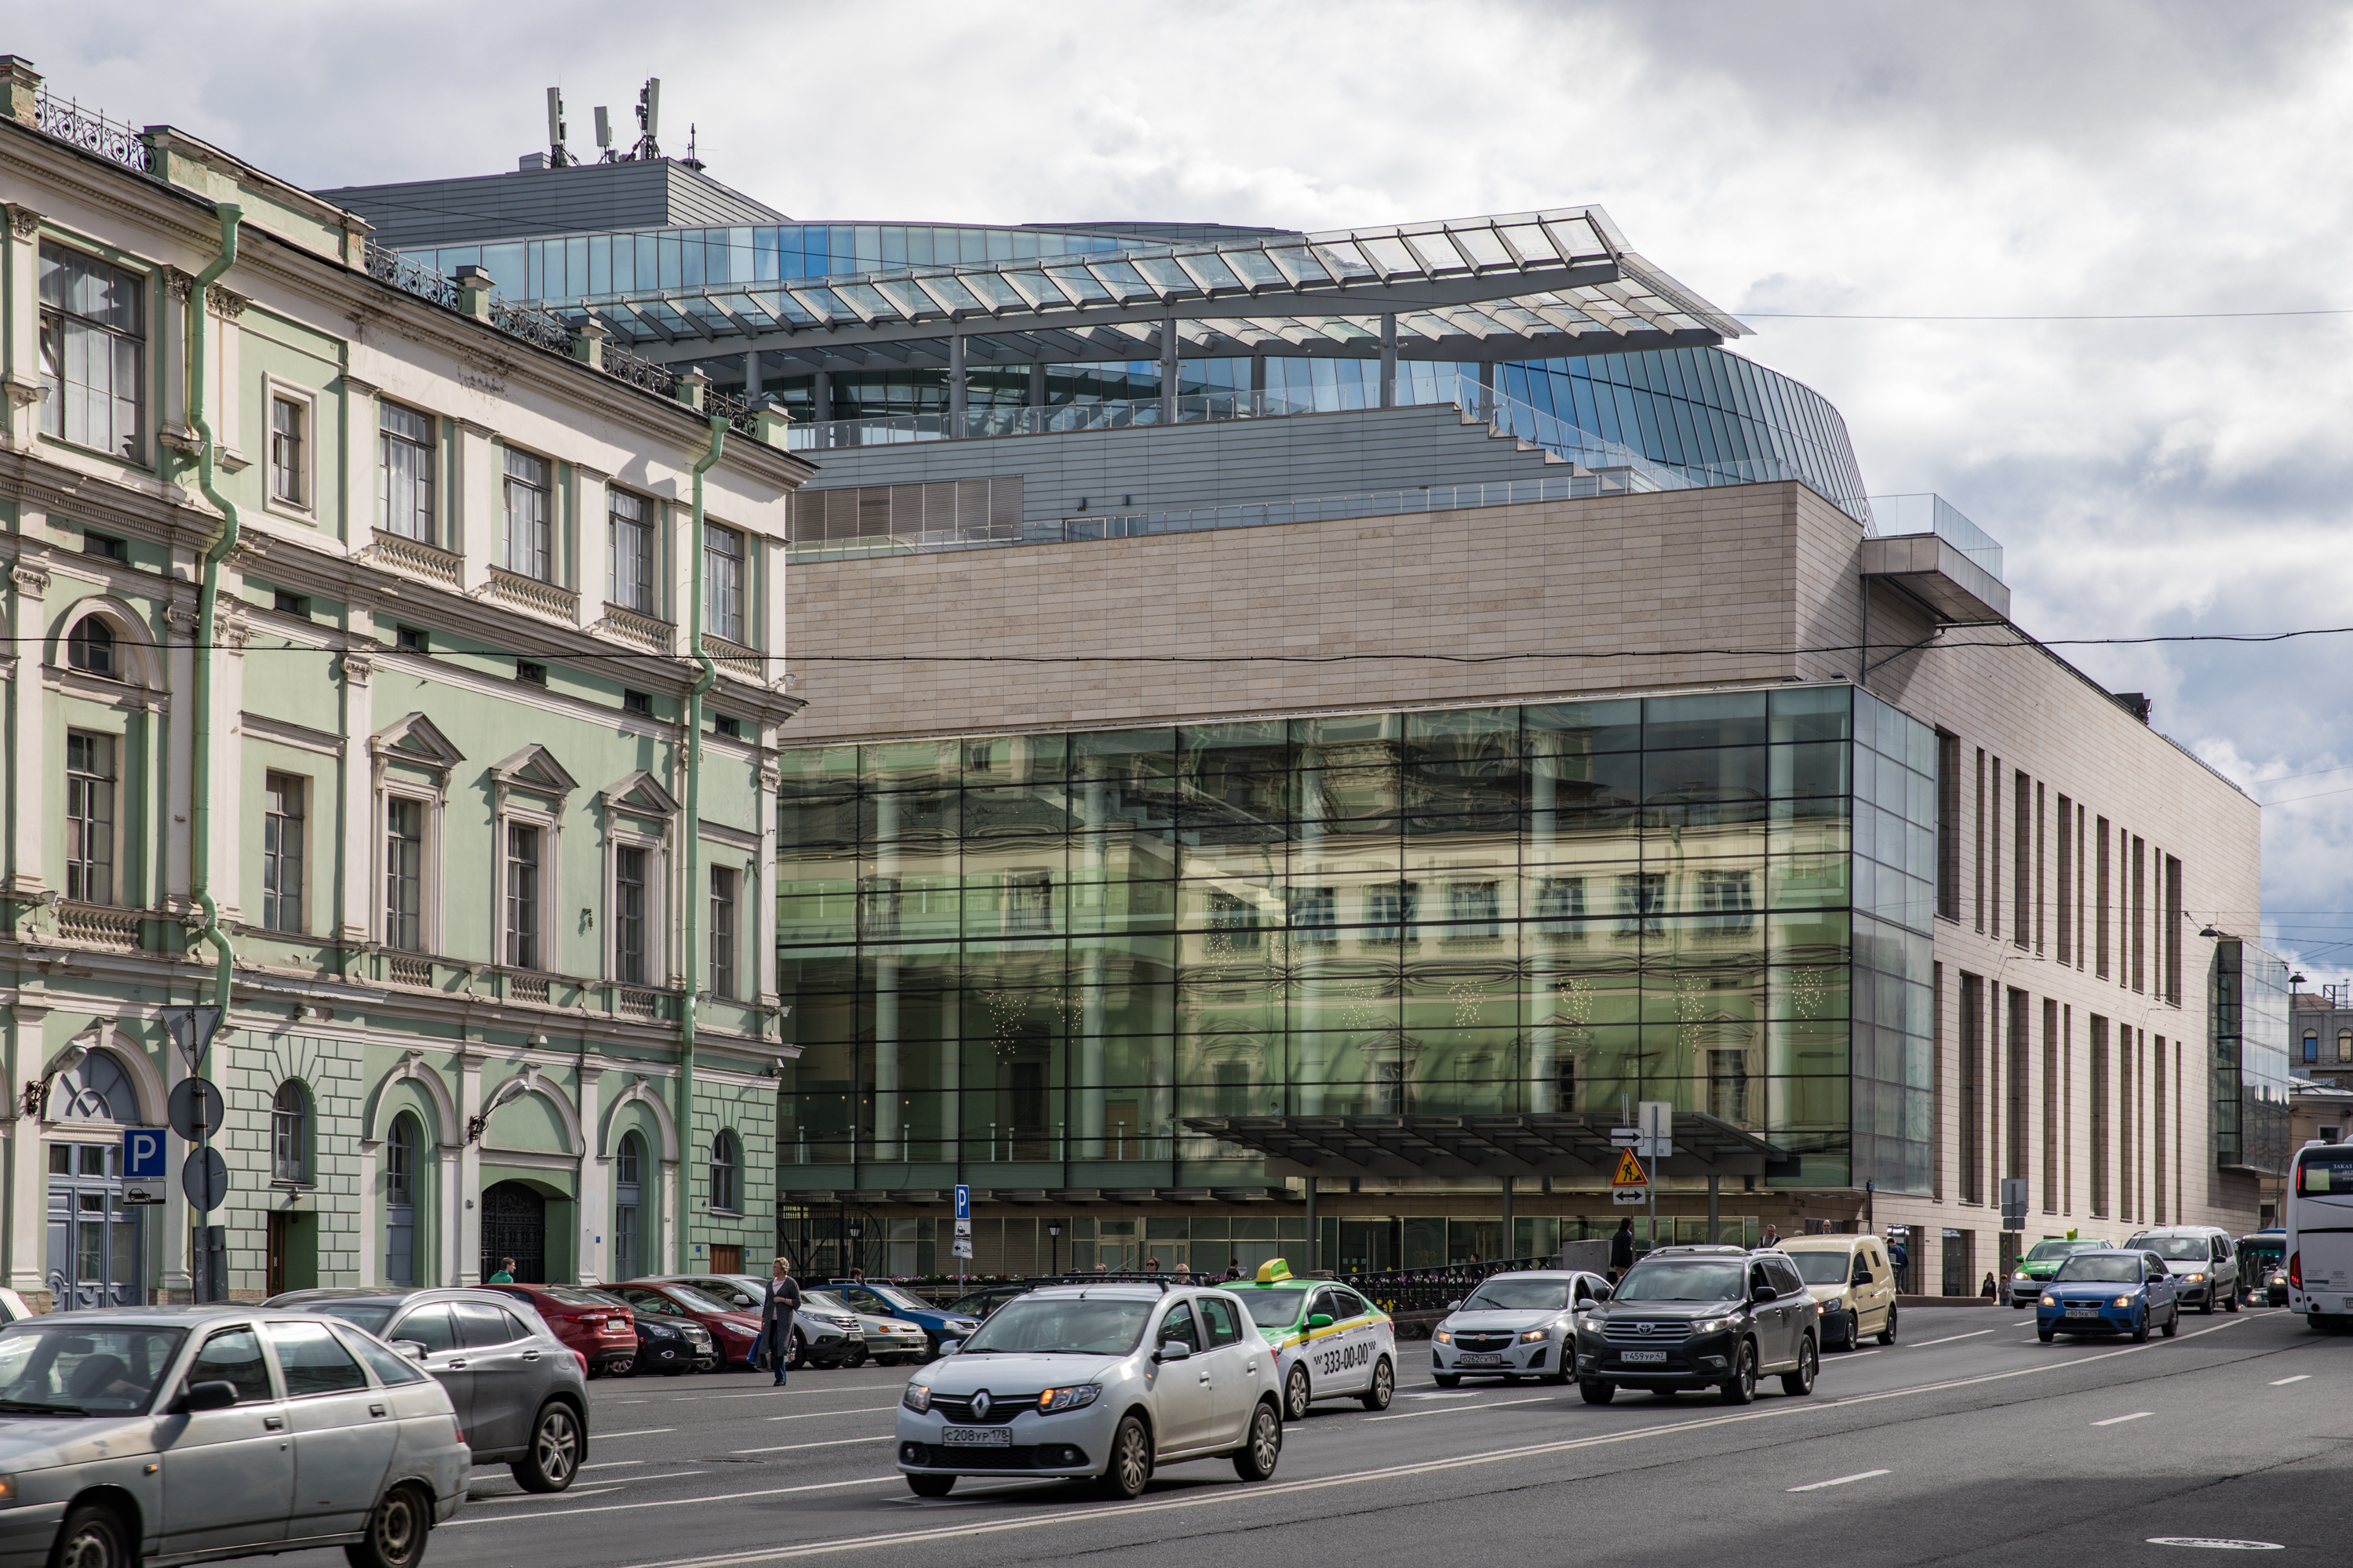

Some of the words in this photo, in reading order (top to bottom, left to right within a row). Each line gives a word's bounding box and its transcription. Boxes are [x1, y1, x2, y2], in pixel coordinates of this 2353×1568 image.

[133, 1134, 156, 1172] P
[958, 1189, 966, 1216] P
[1324, 1342, 1368, 1375] 333-00-00
[945, 1429, 989, 1442] С208УР
[991, 1429, 1008, 1439] 178
